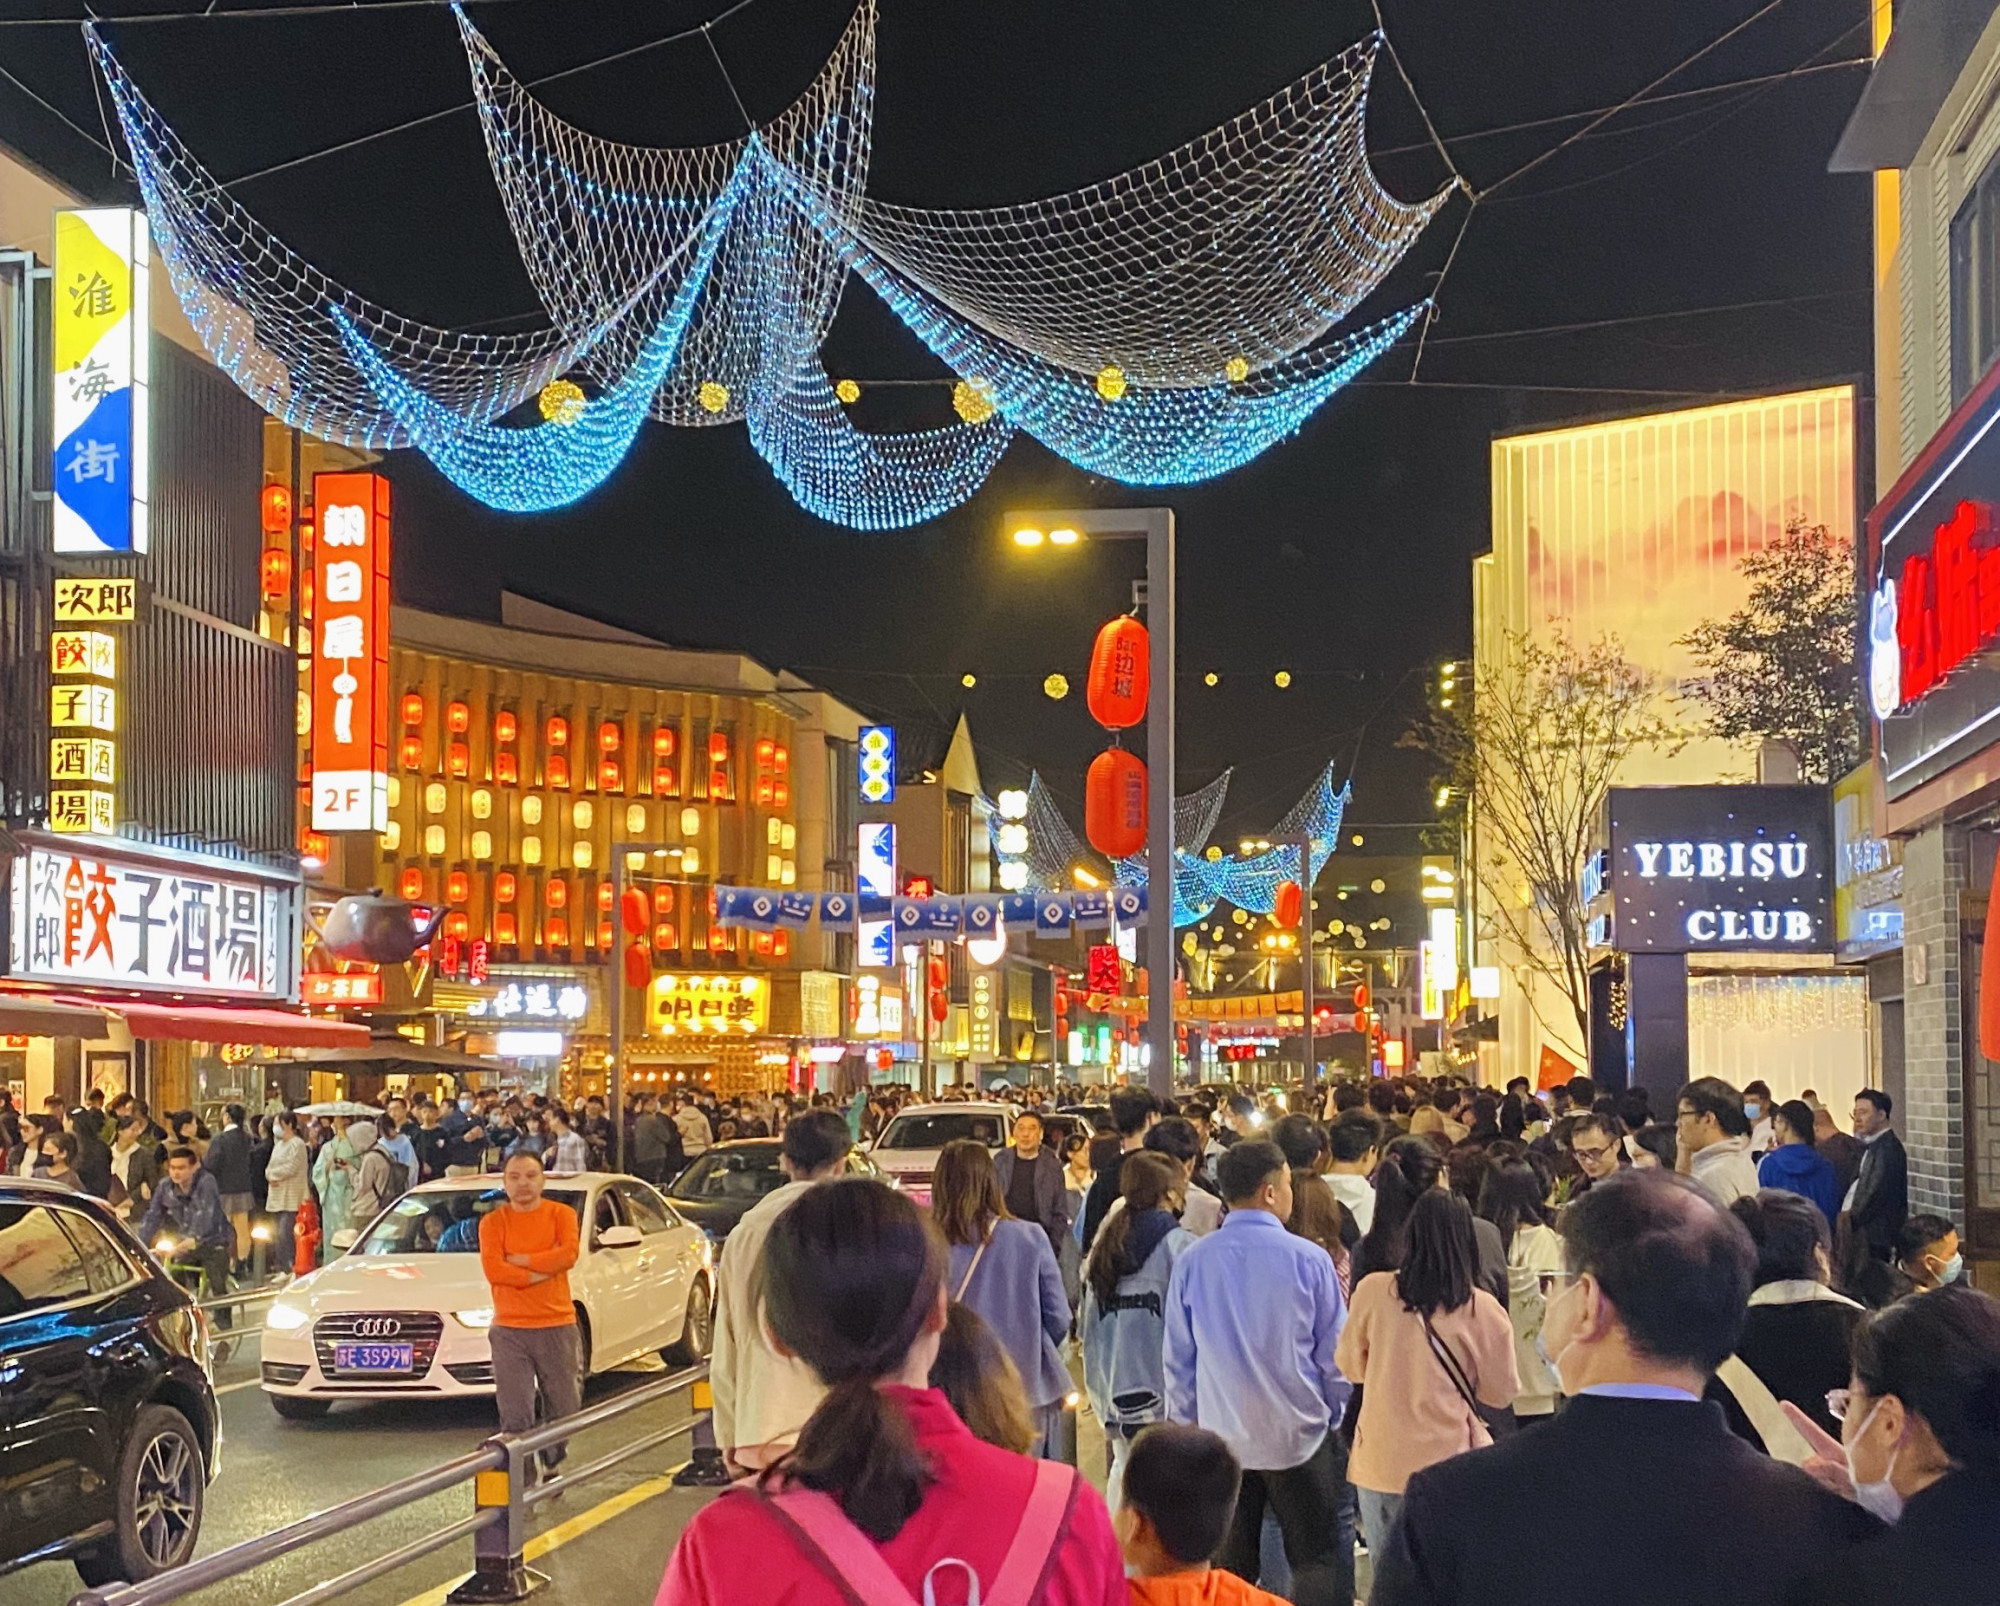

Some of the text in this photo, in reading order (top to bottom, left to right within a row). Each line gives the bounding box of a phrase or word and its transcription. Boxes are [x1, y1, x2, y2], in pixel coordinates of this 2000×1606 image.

[64, 271, 120, 484] 淮海街
[57, 583, 134, 617] 次郎
[55, 636, 88, 828] 餃子酒場
[324, 788, 362, 812] 2F
[1634, 842, 1808, 878] YEBISU
[34, 855, 61, 970] 次郎
[64, 856, 258, 983] 餃子酒場
[1687, 911, 1812, 940] CLUB
